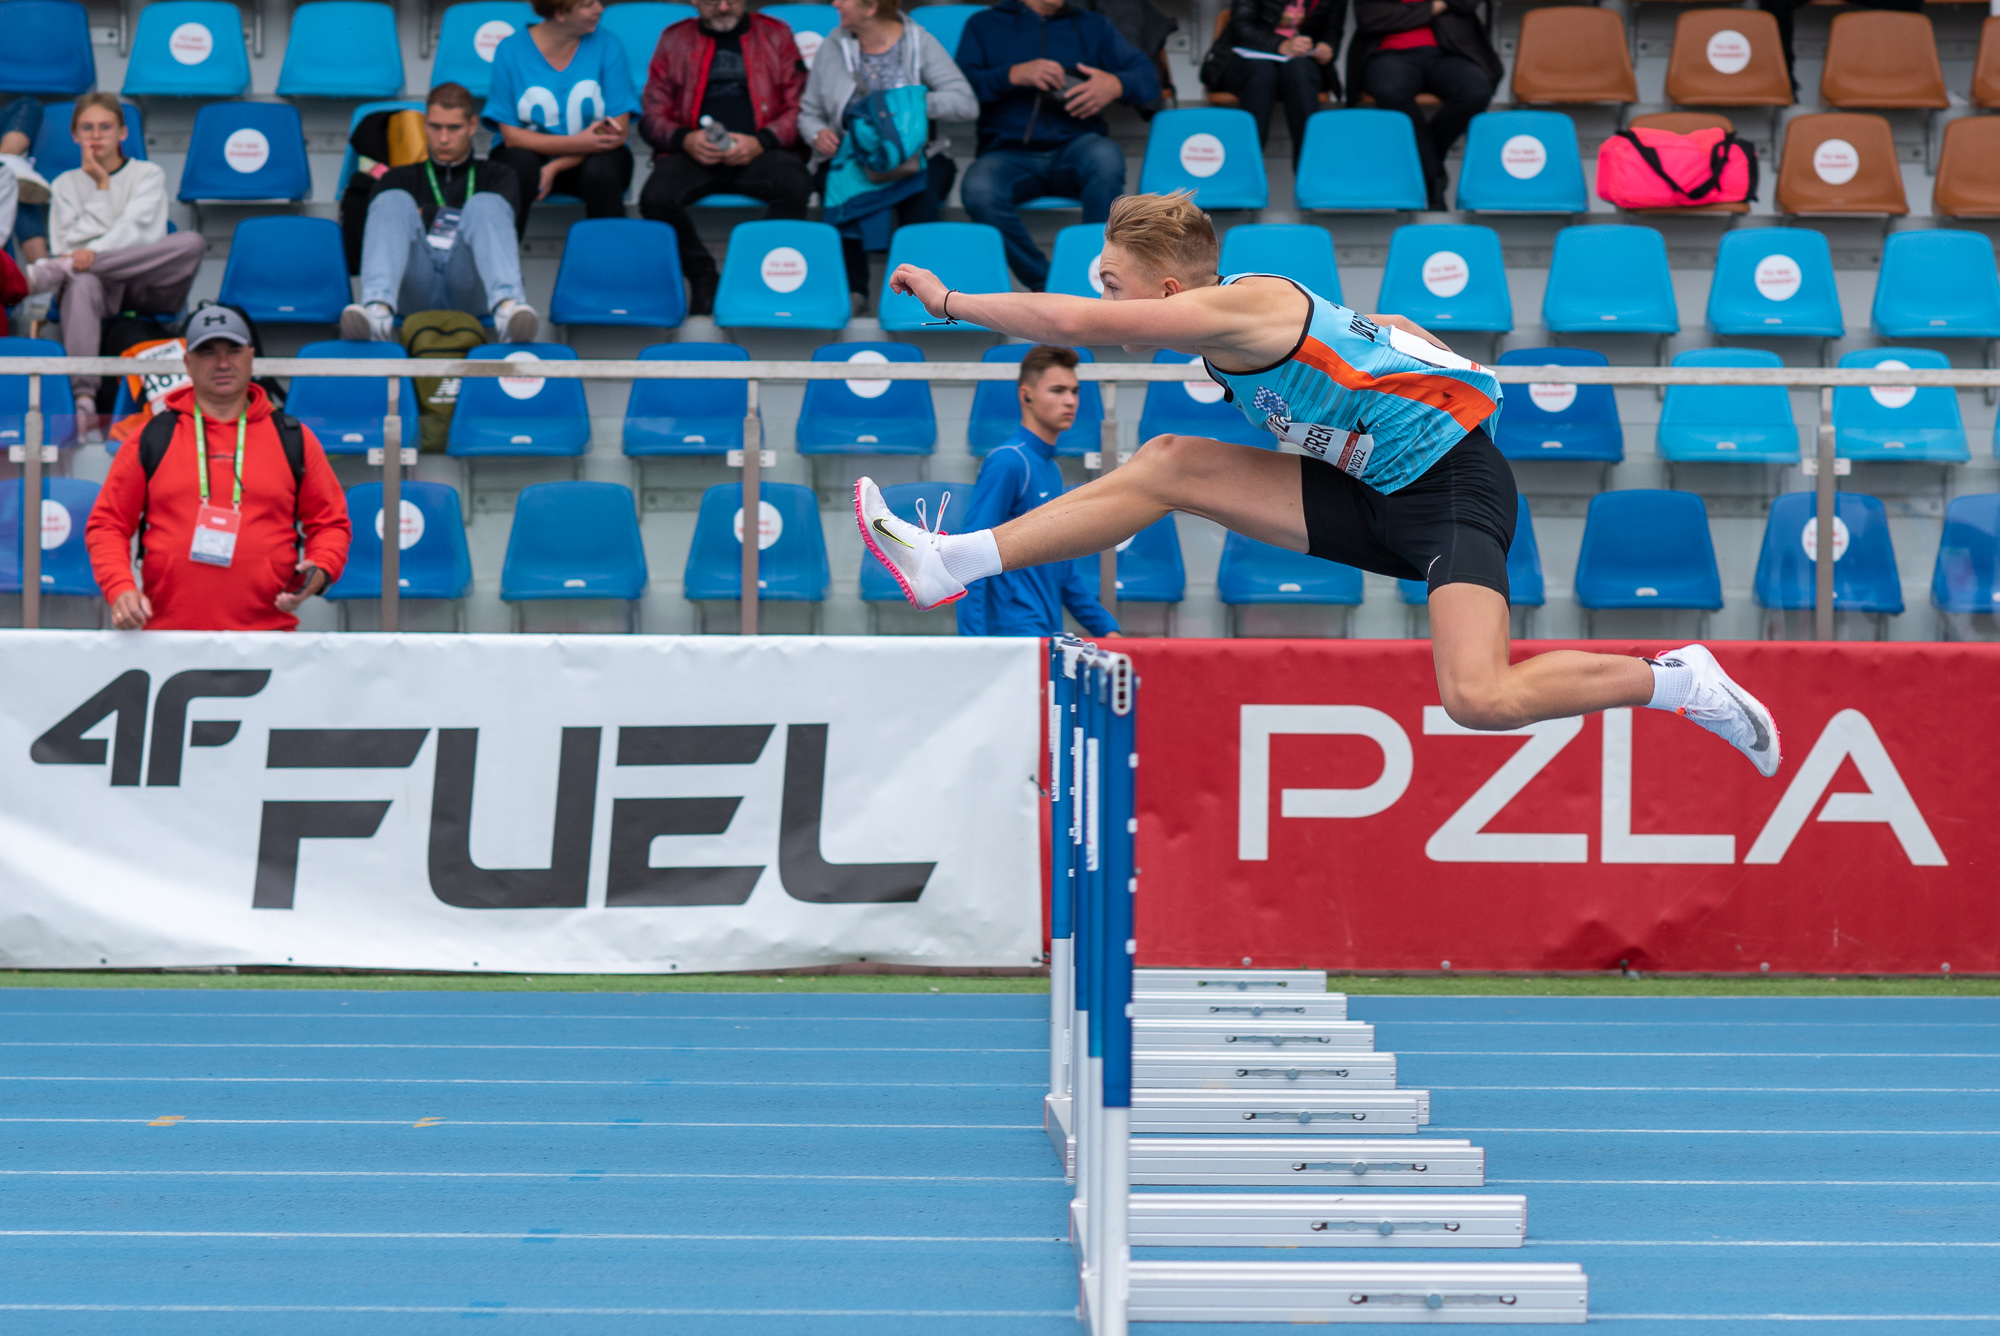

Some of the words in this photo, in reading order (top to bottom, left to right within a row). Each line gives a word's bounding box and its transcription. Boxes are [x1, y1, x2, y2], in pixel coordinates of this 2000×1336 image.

[30, 669, 272, 787] 4F
[1238, 704, 1949, 866] PZLA
[252, 723, 938, 910] FUEL
